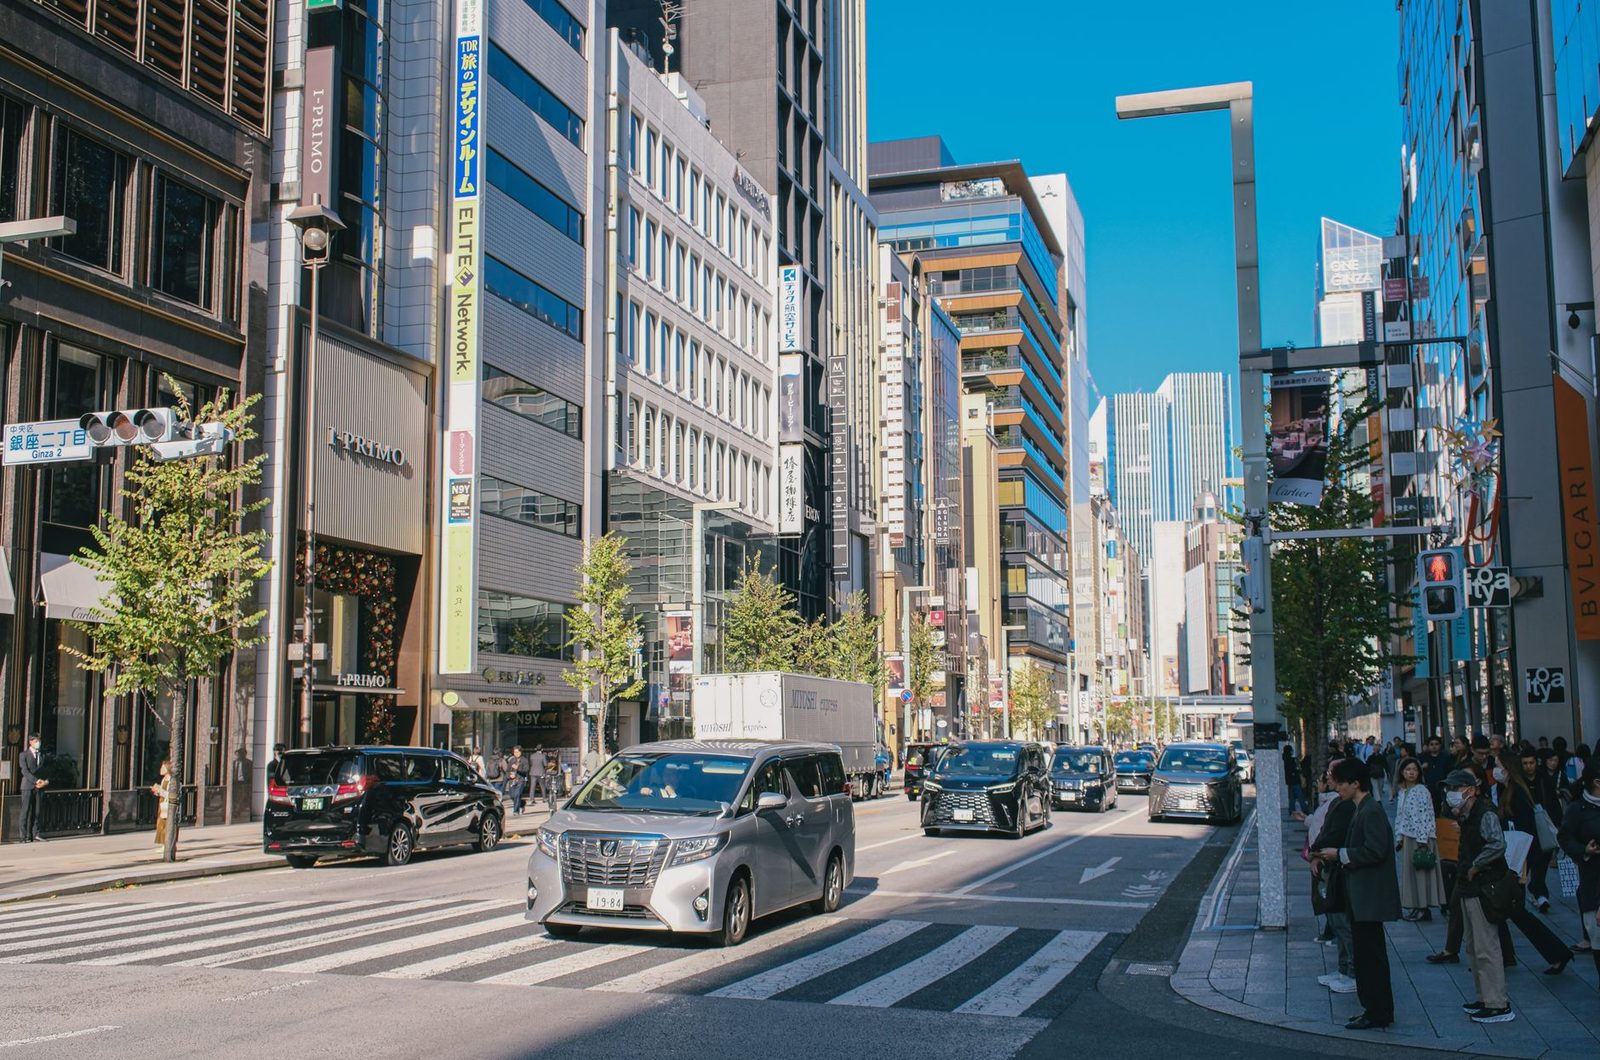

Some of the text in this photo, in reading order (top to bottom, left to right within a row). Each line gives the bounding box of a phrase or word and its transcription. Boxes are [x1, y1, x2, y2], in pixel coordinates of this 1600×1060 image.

[461, 40, 478, 52] TDR
[459, 54, 477, 193] 旅のデザインルーム
[309, 88, 324, 174] I-PRIMO
[458, 207, 473, 267] ELITE
[10, 424, 34, 433] 中央区
[10, 429, 86, 451] 銀座二丁目
[328, 426, 406, 465] I-PRIMO
[31, 448, 62, 459] Ginza 2
[452, 485, 470, 494] N9Y
[1274, 484, 1313, 498] Cartier
[1568, 465, 1598, 617] BVLGARI
[71, 606, 101, 620] Cartier
[337, 674, 386, 687] I-PRIMO
[791, 690, 817, 710] MIYOSHI
[701, 722, 732, 732] MIYOSHI
[596, 897, 621, 908] 19-84
